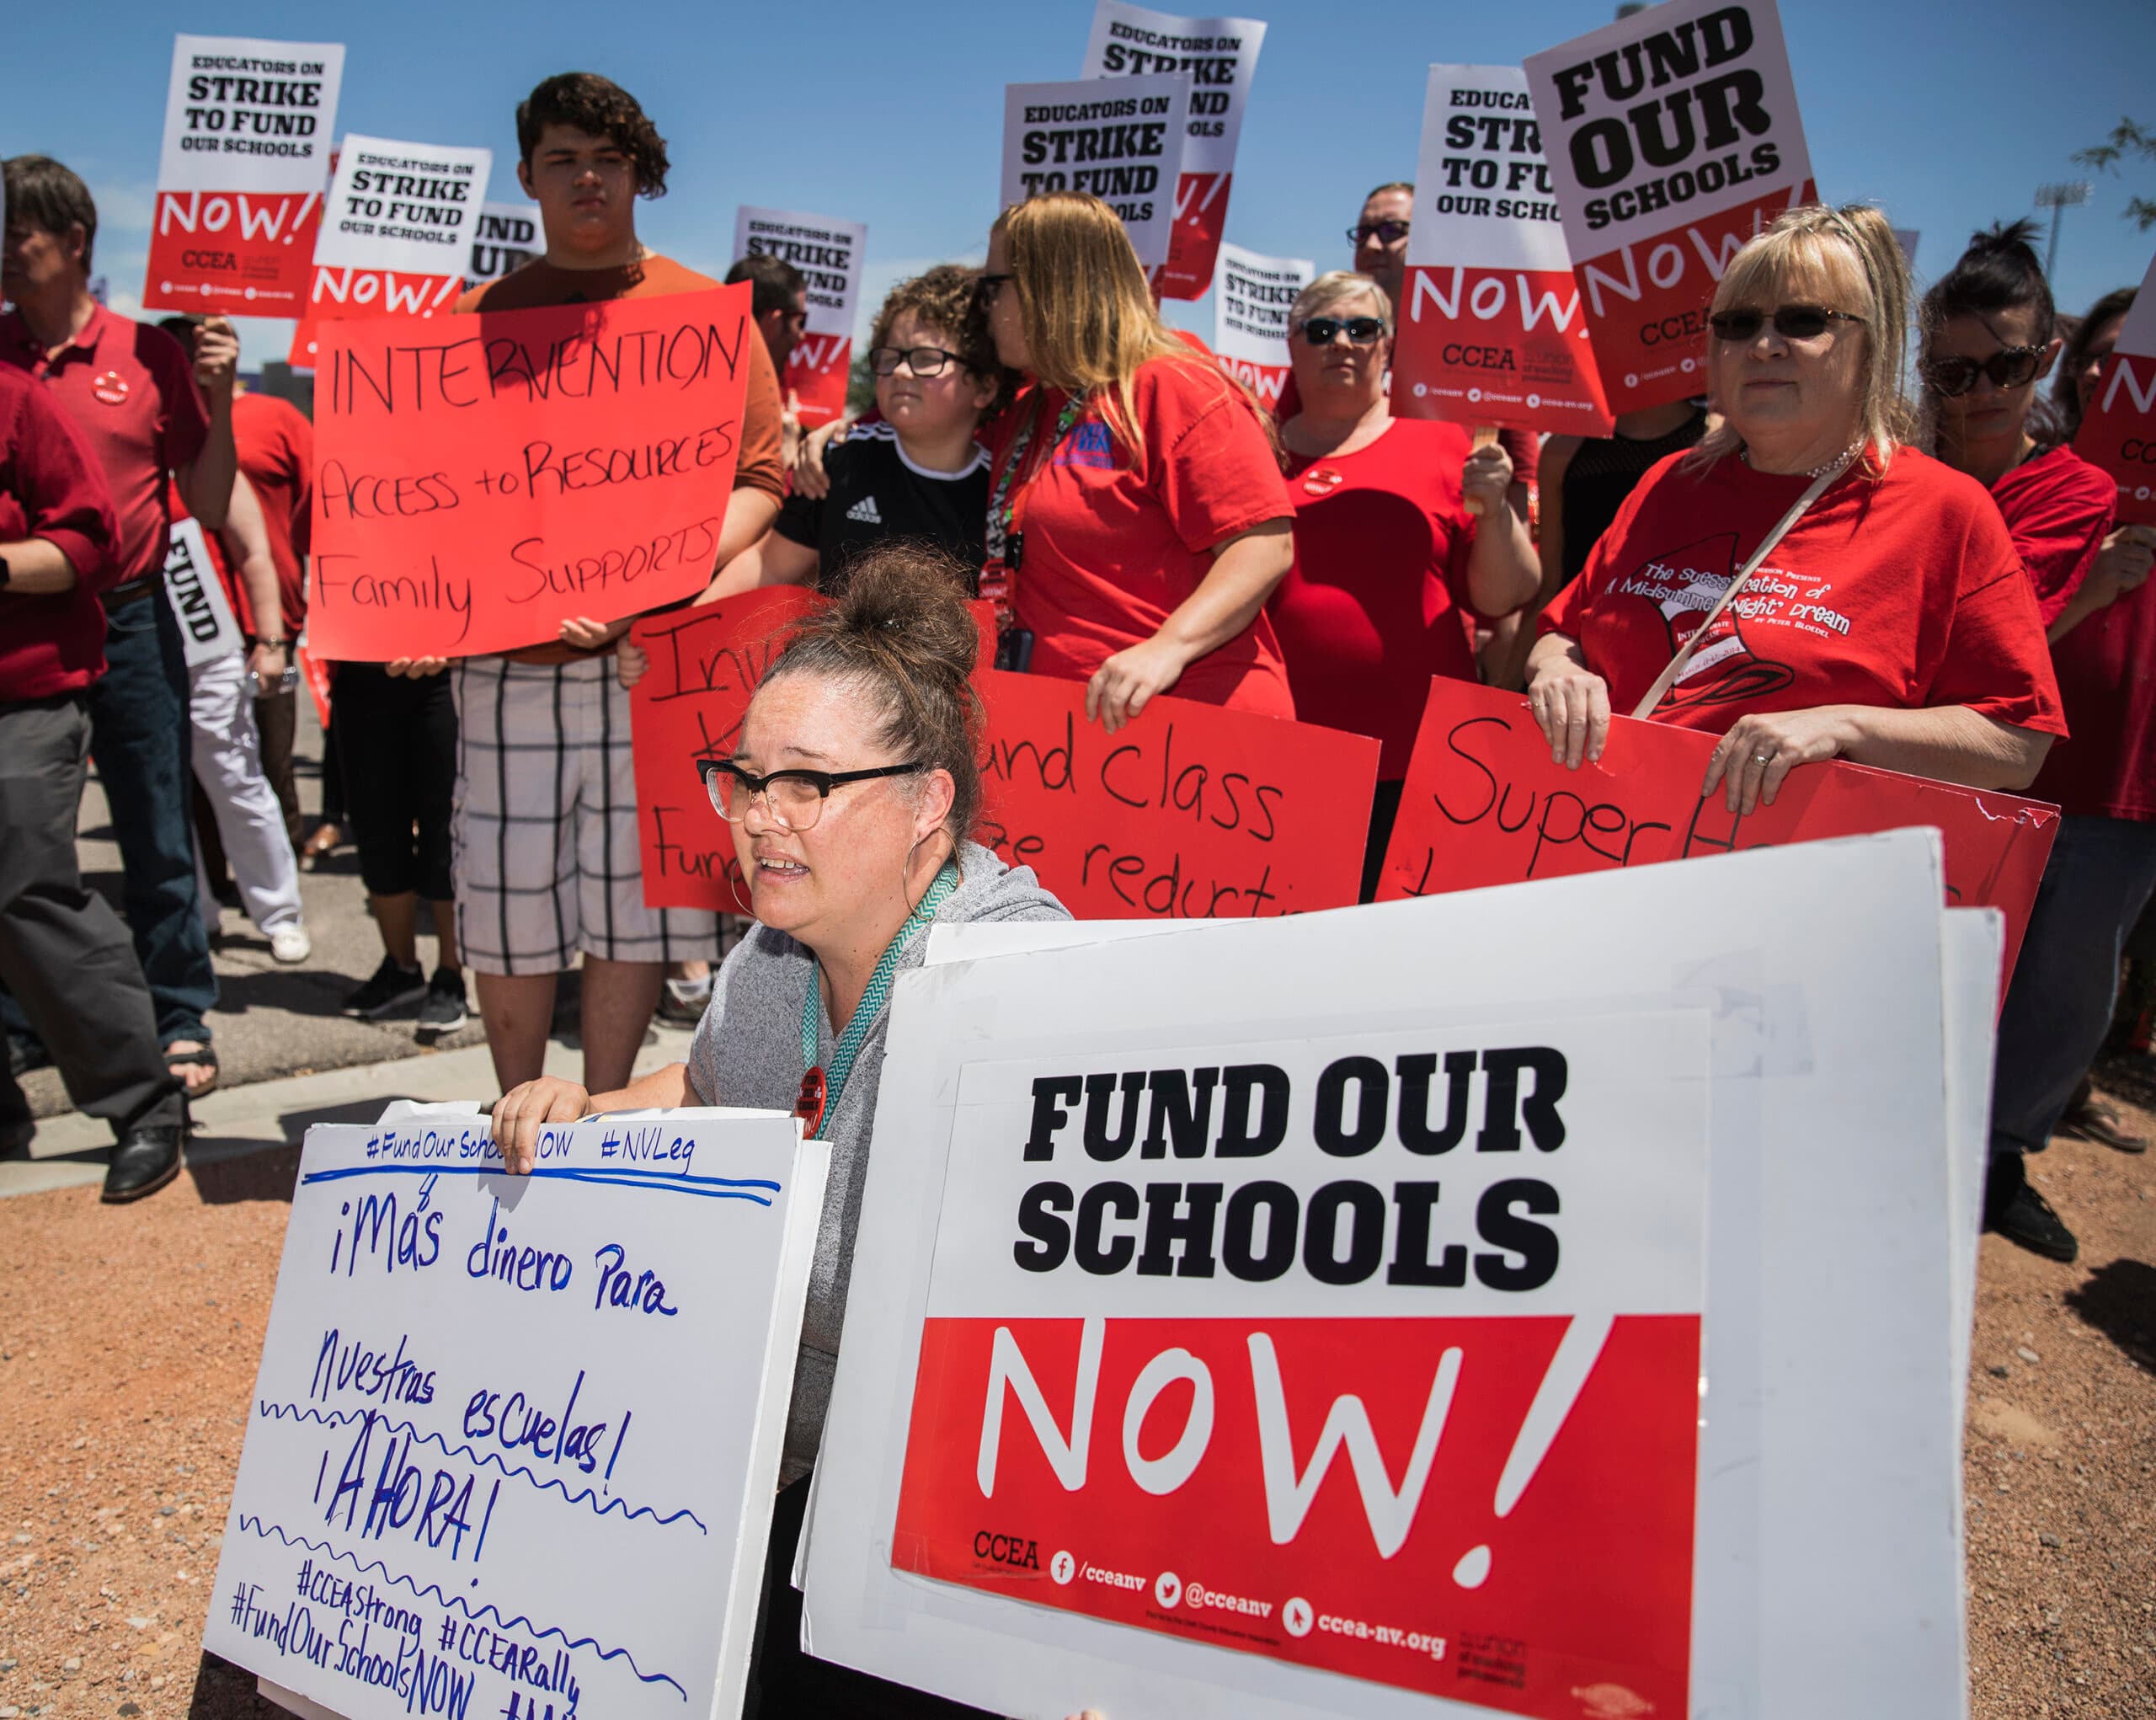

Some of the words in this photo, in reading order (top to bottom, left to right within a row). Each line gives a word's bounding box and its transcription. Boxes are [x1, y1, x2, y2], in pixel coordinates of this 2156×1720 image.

[1110, 22, 1213, 51] EDUCATORS
[1217, 37, 1241, 51] ON
[192, 56, 295, 75] EDUCATORS
[301, 62, 324, 75] ON
[1551, 5, 1754, 121] FUND
[189, 77, 322, 107] STRIKE
[1024, 99, 1137, 123] EDUCATORS
[1141, 97, 1170, 115] ON
[1190, 93, 1230, 115] ND
[1450, 89, 1529, 110] EDUCA
[186, 108, 225, 131] TO
[232, 111, 317, 136] FUND
[1446, 115, 1542, 154] STR
[1569, 68, 1772, 190] OUR
[181, 136, 219, 152] OUR
[224, 138, 312, 158] SCHOOLS
[357, 152, 448, 174] EDUCATORS
[453, 164, 474, 175] ON
[1022, 123, 1166, 164] STRIKE
[350, 171, 470, 202] STRIKE
[1073, 165, 1159, 197] FUND
[1442, 158, 1498, 189] TO
[1505, 162, 1554, 194] FU
[1584, 142, 1781, 231] SCHOOLS
[160, 193, 321, 245] NOW!
[347, 196, 382, 218] TO
[388, 200, 463, 227] FUND
[1437, 195, 1490, 216] OUR
[1496, 199, 1561, 222] SCHO
[340, 221, 374, 236] OUR
[379, 225, 457, 245] SCHOOLS
[181, 249, 237, 271] CCEA
[747, 237, 852, 270] STRIKE
[312, 267, 462, 319] NOW!
[1411, 268, 1588, 339] NOW
[1249, 304, 1285, 324] FUN
[333, 315, 745, 415] INTERVENTION
[789, 334, 848, 374] W!
[1443, 344, 1516, 371] CCEA
[1219, 356, 1288, 398] NOW
[475, 467, 519, 496] to
[523, 420, 735, 499] RESOURCES
[169, 537, 220, 644] FUND
[316, 553, 472, 648] Family
[1644, 564, 1675, 580] The
[1805, 584, 1832, 600] of
[1789, 603, 1851, 635] Dream
[1101, 723, 1283, 842] Class
[1433, 718, 1671, 879] Super
[1083, 845, 1302, 919] reduct
[1022, 1063, 1292, 1162] FUND
[1313, 1045, 1569, 1158] OUR
[600, 1130, 696, 1174] #NVLeg
[1011, 1177, 1562, 1293] SCHOOLS
[467, 1197, 573, 1291] dinero
[595, 1243, 678, 1315] Para
[463, 1370, 632, 1495] escuelas!
[976, 1314, 1614, 1589] NOW!
[974, 1530, 1040, 1571] CCEA
[1078, 1561, 1146, 1592] /cceanv
[1186, 1582, 1273, 1619] @cceanv
[1318, 1612, 1447, 1661] ccea-nv.org
